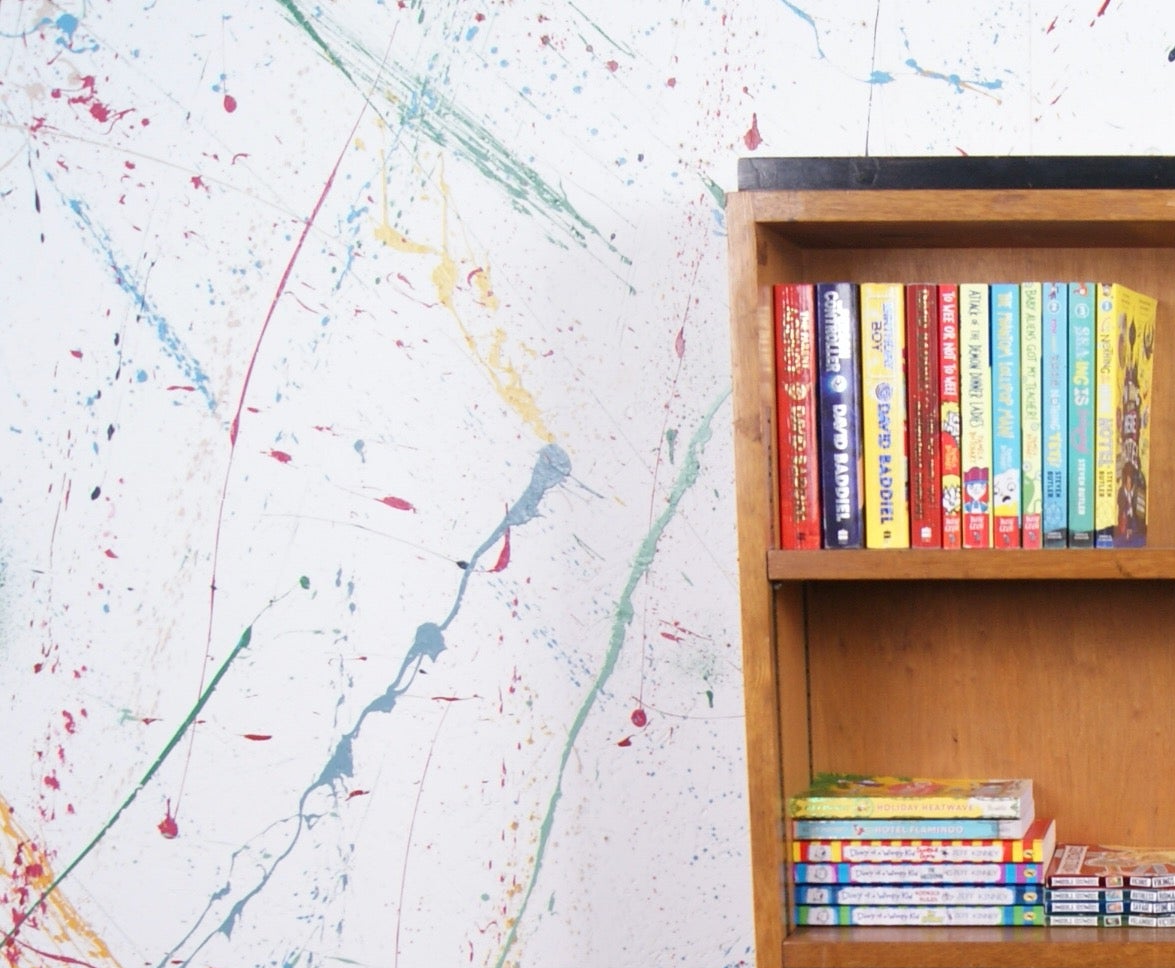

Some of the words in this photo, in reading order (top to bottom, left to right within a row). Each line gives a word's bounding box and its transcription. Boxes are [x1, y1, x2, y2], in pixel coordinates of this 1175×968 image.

[943, 290, 956, 302] TO
[968, 290, 980, 316] ATTACK
[1025, 289, 1037, 310] BABY
[943, 304, 956, 324] WEE
[1025, 313, 1037, 340] ALIENS
[824, 290, 841, 373] CONTROLLER
[872, 320, 882, 352] BOY
[943, 326, 956, 340] OR
[943, 342, 957, 361] NOT
[969, 344, 980, 370] DEMON
[1026, 343, 1038, 362] GOT
[1099, 334, 1113, 374] NOTHING
[944, 364, 957, 375] TO
[1027, 366, 1036, 379] MY
[969, 372, 983, 398] DINNER
[1074, 387, 1089, 406] IS
[832, 403, 848, 450] DAVID
[878, 403, 891, 450] DAVID
[969, 401, 984, 428] LADIES
[1077, 458, 1085, 485] STEVEN
[834, 453, 850, 522] BADDIEL
[879, 455, 893, 525] BADDIEL
[1077, 487, 1085, 515] BUTLER
[875, 826, 906, 834] HOTEL
[909, 825, 964, 833] FLAMINGO
